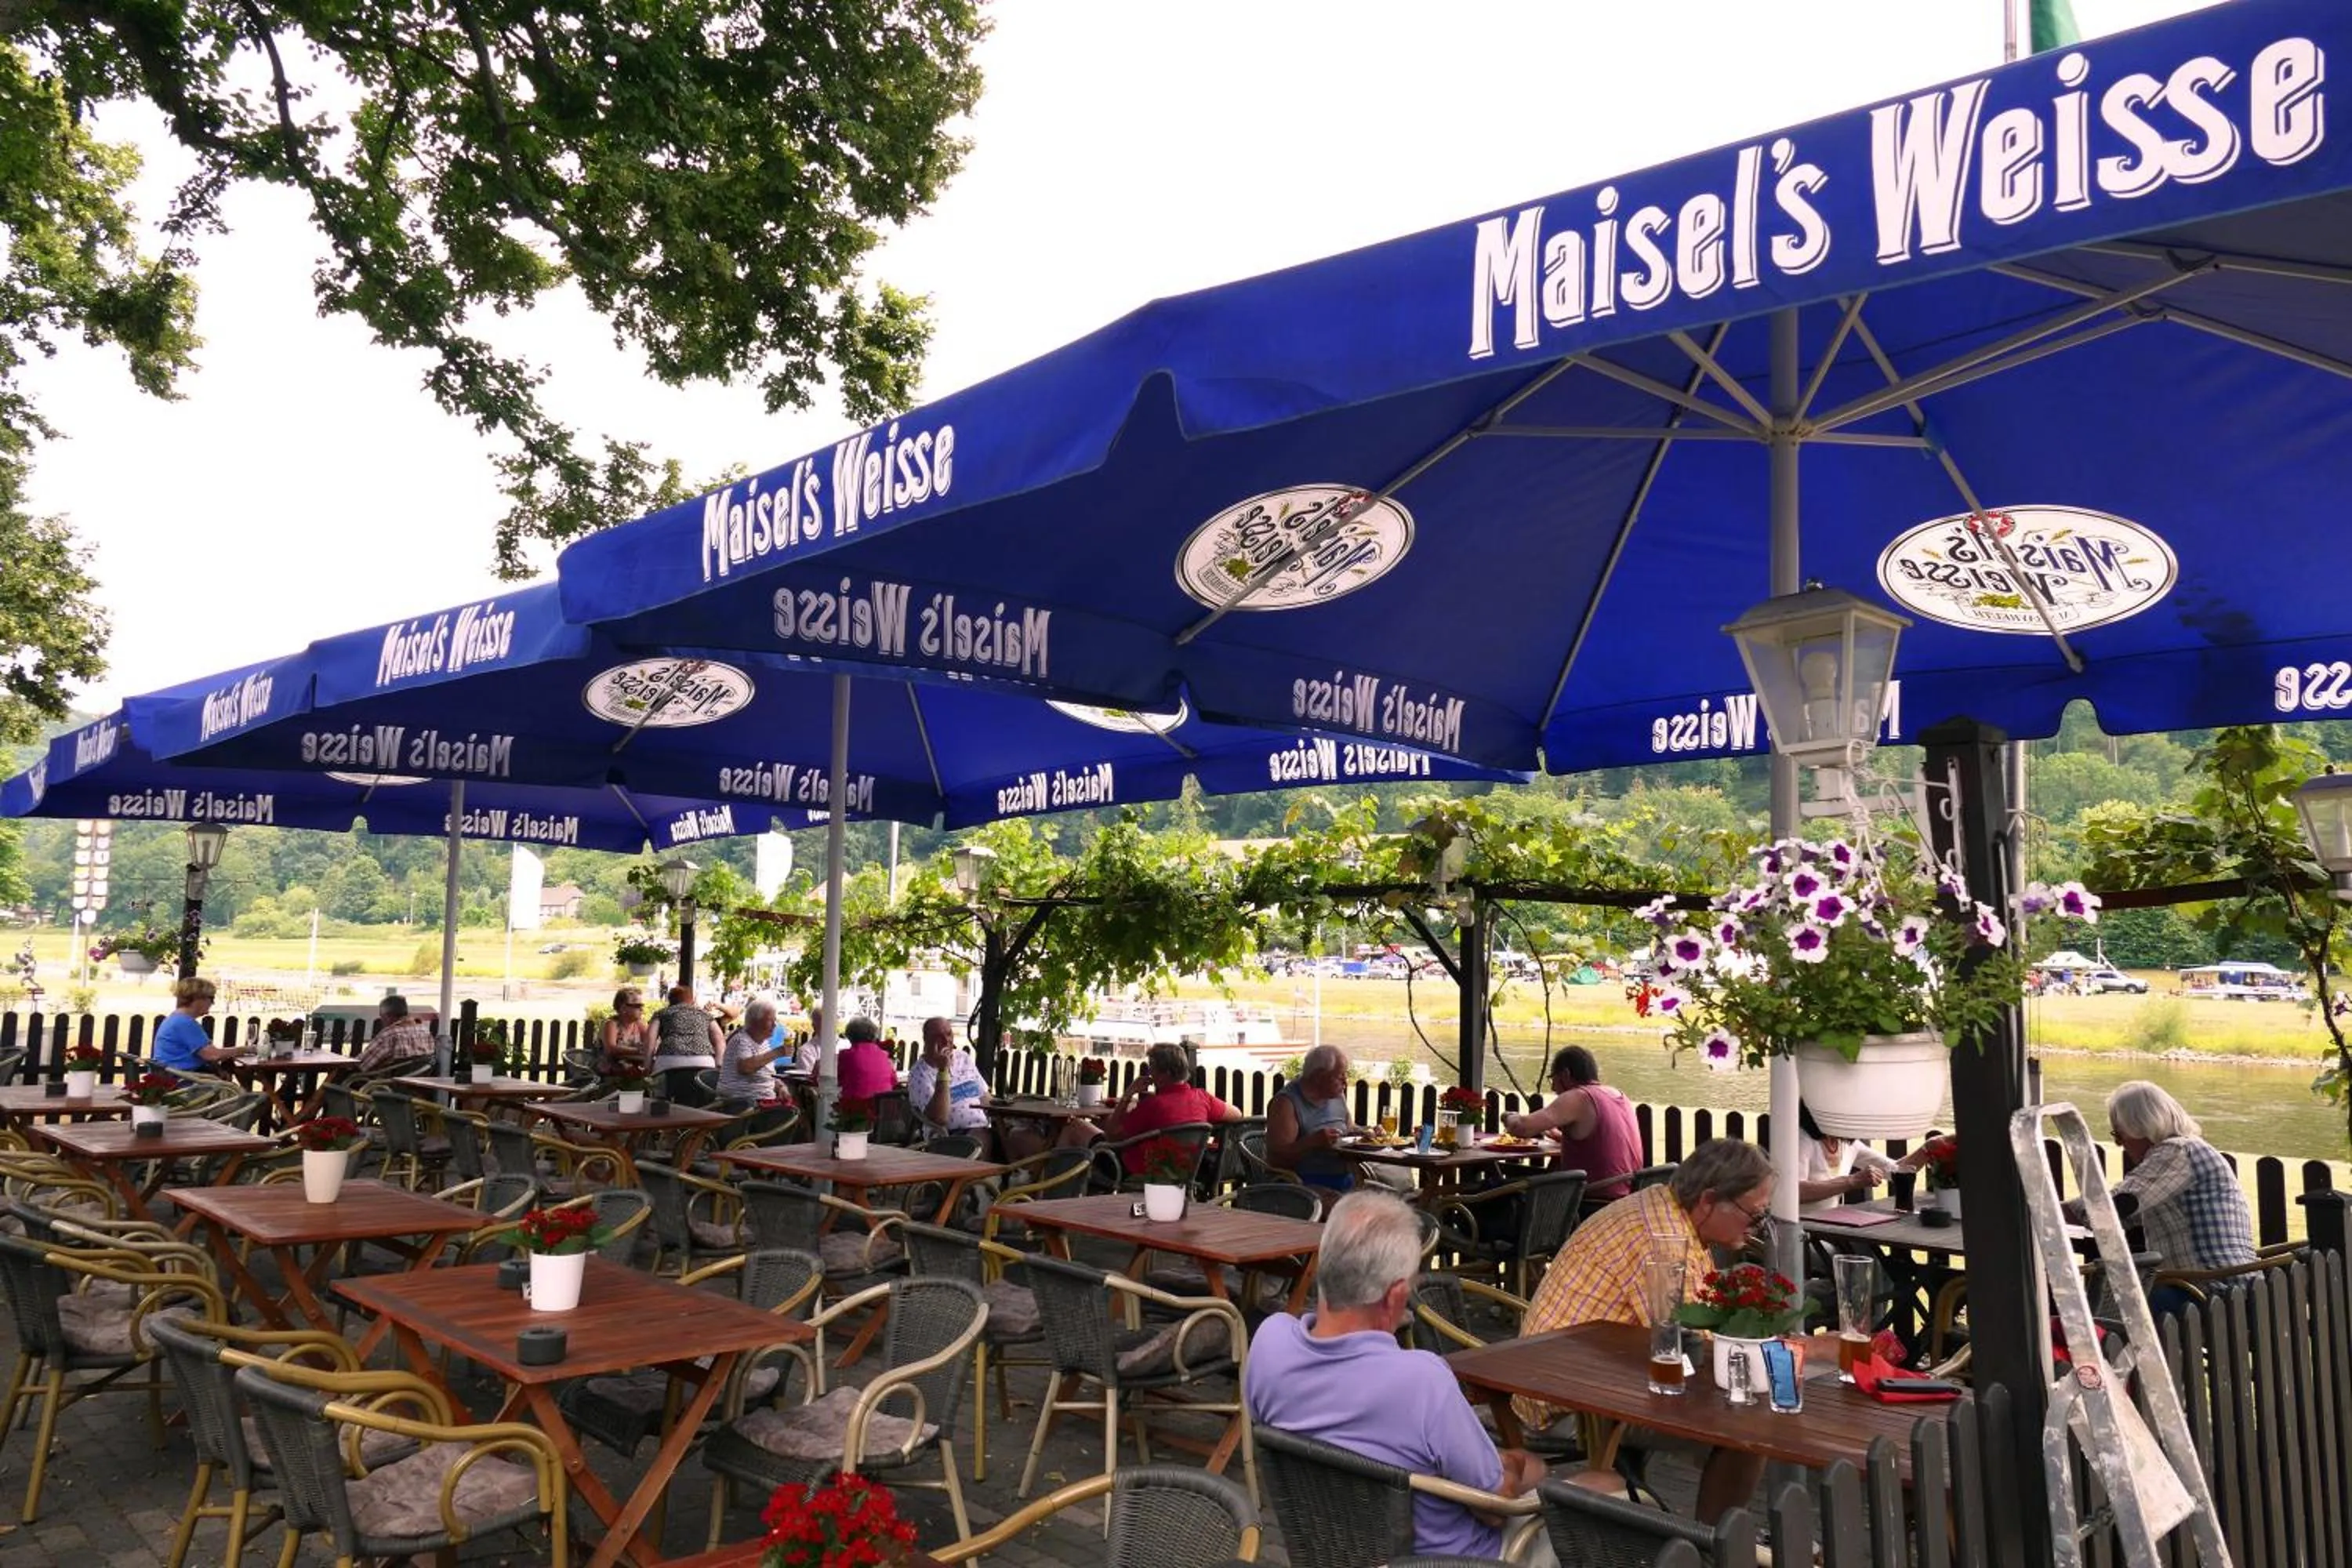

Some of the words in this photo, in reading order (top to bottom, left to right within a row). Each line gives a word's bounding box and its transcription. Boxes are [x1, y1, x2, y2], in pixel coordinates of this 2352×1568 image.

[1468, 137, 1830, 359] Maisel's
[1870, 36, 2325, 264] Weisse
[702, 457, 822, 583] Maisel's
[833, 419, 955, 537] Weisse
[376, 613, 449, 688] Maisel's
[447, 601, 515, 673] Weisse
